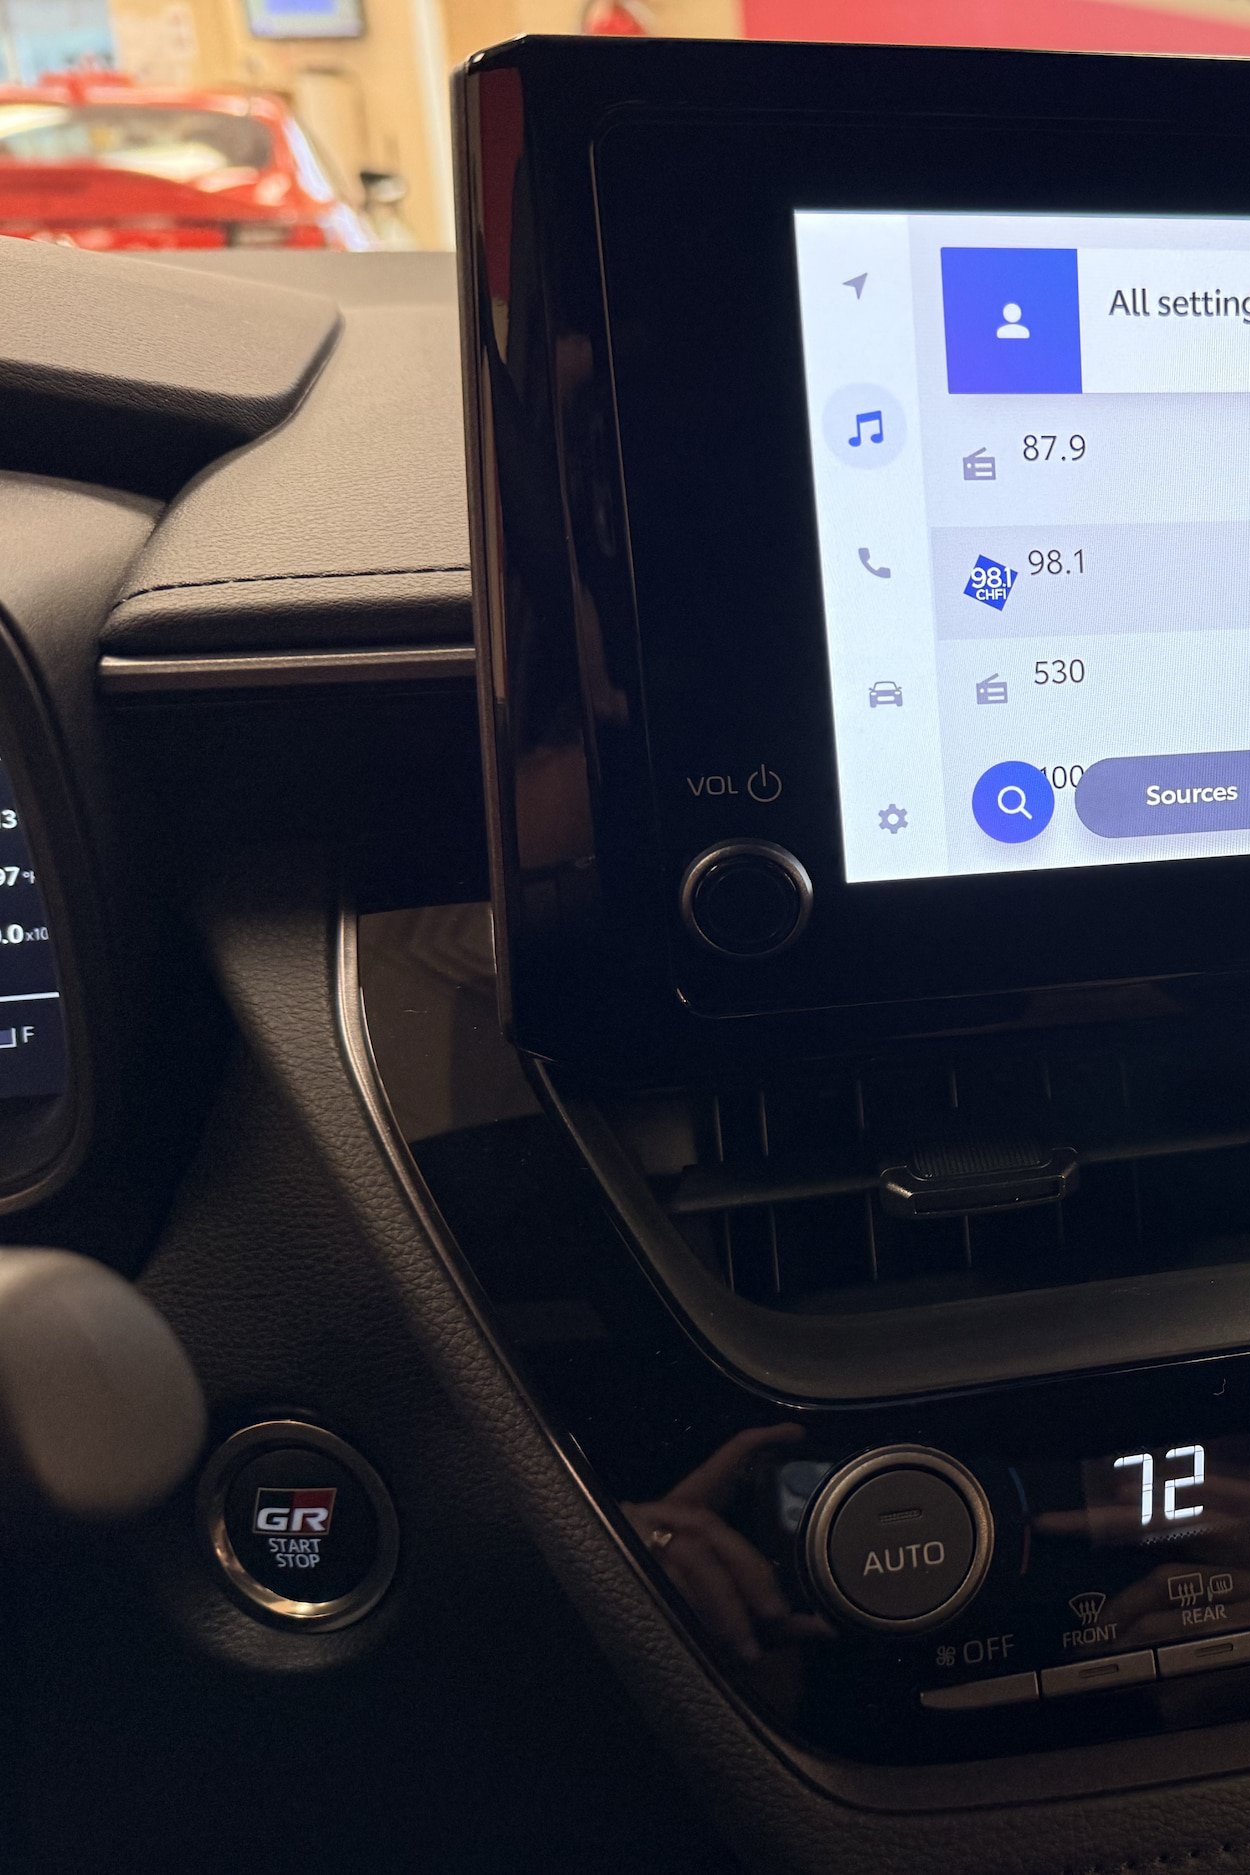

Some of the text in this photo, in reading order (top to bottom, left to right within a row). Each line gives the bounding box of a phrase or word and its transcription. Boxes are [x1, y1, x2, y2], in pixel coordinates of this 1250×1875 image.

[1108, 288, 1150, 317] All
[1022, 434, 1087, 462] 87.9
[1028, 548, 1085, 576] 98.1
[970, 566, 1012, 589] 98.1
[975, 588, 1007, 601] CHFI
[1033, 659, 1086, 685] 530
[686, 775, 739, 796] VOL
[1146, 784, 1239, 806] Sources
[22, 1026, 35, 1043] F
[1113, 1444, 1205, 1526] 72
[256, 1507, 330, 1532] GR
[268, 1538, 322, 1554] START
[863, 1540, 946, 1576] AUTO
[275, 1553, 321, 1569] STOP
[1182, 1604, 1228, 1626] REAR
[963, 1634, 1016, 1664] OFF
[1062, 1624, 1118, 1649] FRONT
